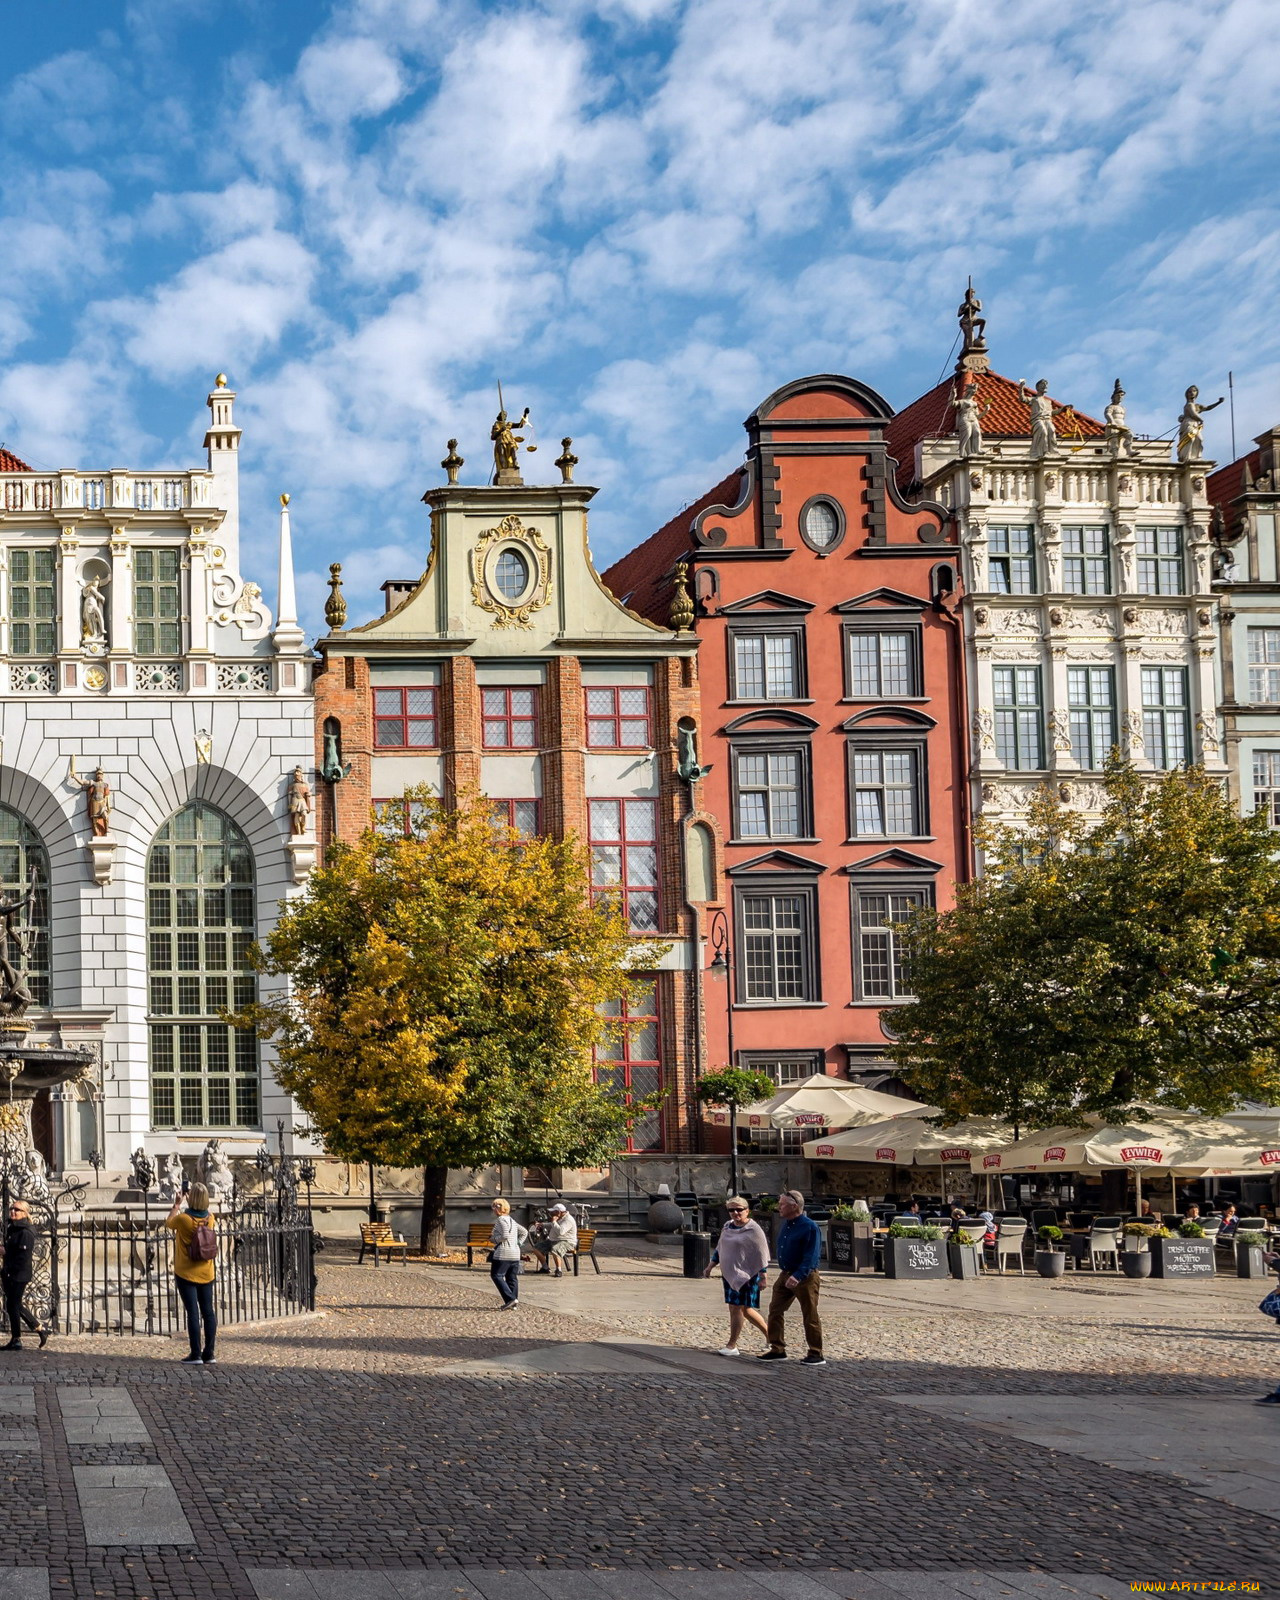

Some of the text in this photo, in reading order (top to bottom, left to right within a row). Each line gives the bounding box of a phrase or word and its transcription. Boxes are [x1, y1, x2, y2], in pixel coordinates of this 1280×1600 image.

[1124, 1147, 1157, 1158] ŻYWIEC
[1187, 1246, 1210, 1254] COFFEE
[918, 1258, 939, 1267] WINE
